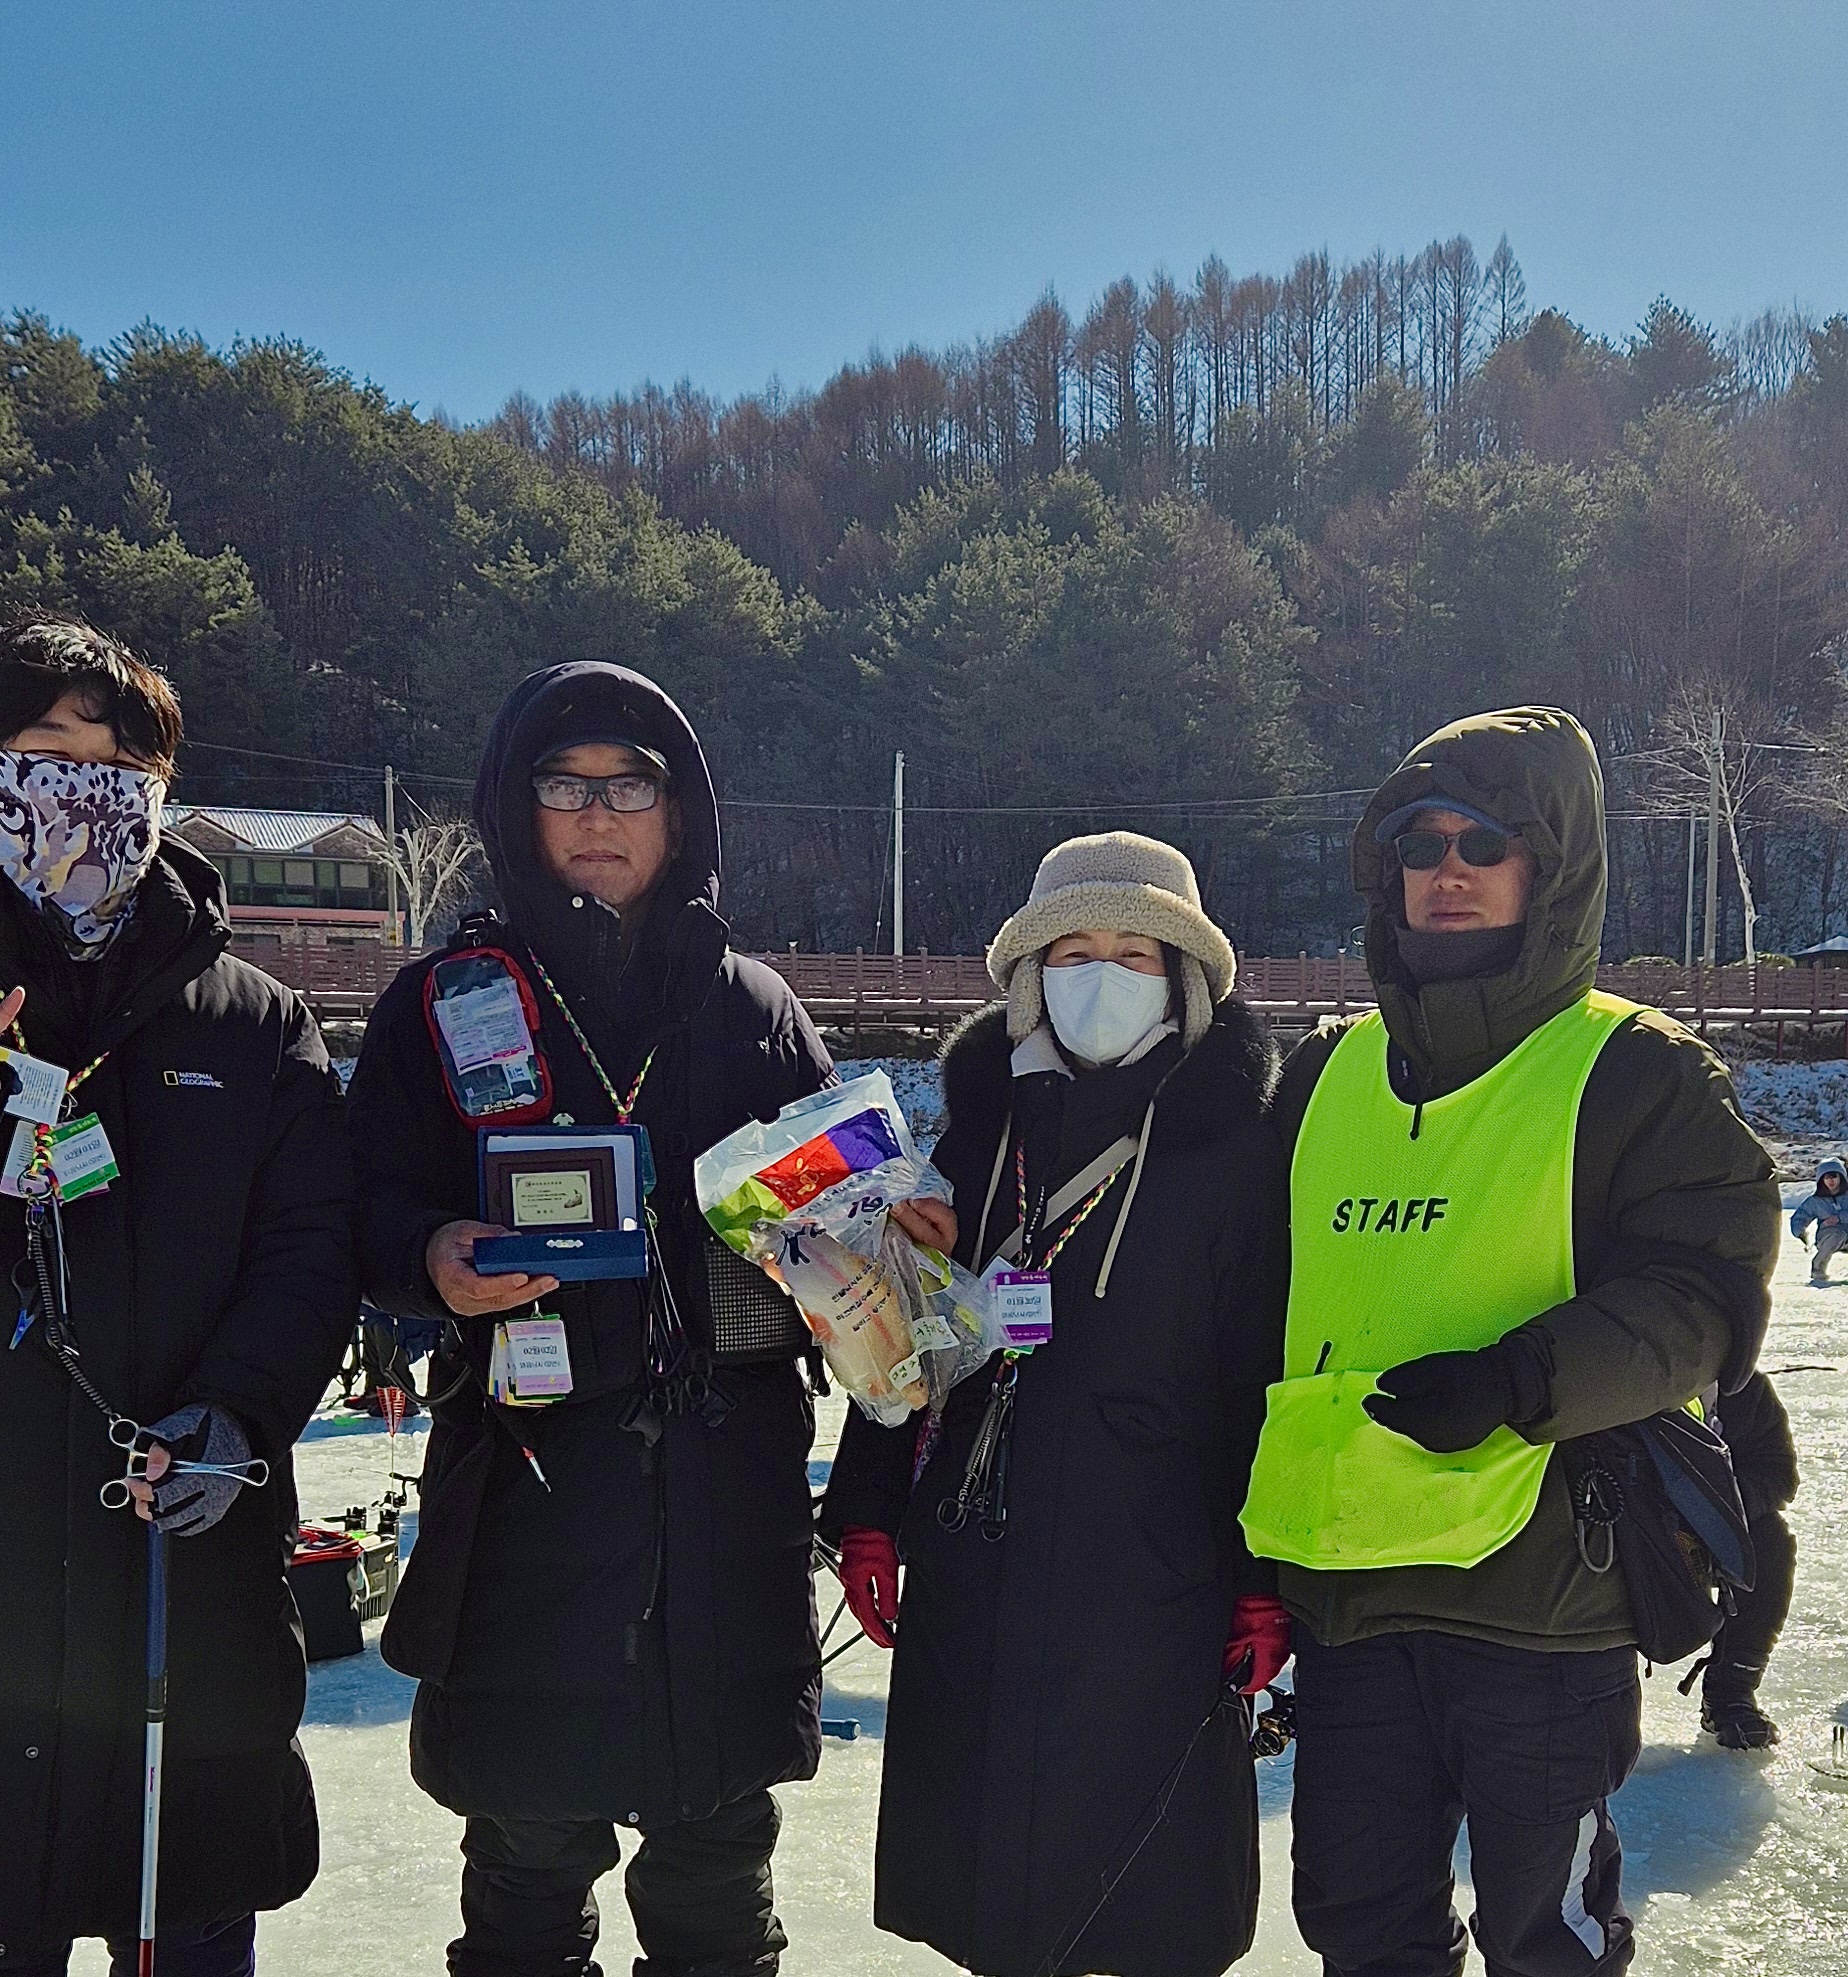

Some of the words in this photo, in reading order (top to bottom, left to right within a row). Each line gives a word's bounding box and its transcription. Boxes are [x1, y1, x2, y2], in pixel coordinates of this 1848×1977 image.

[178, 1071, 213, 1080] NATIONAL
[180, 1078, 225, 1088] GEOGRAPHIC
[1332, 1197, 1449, 1233] STAFF
